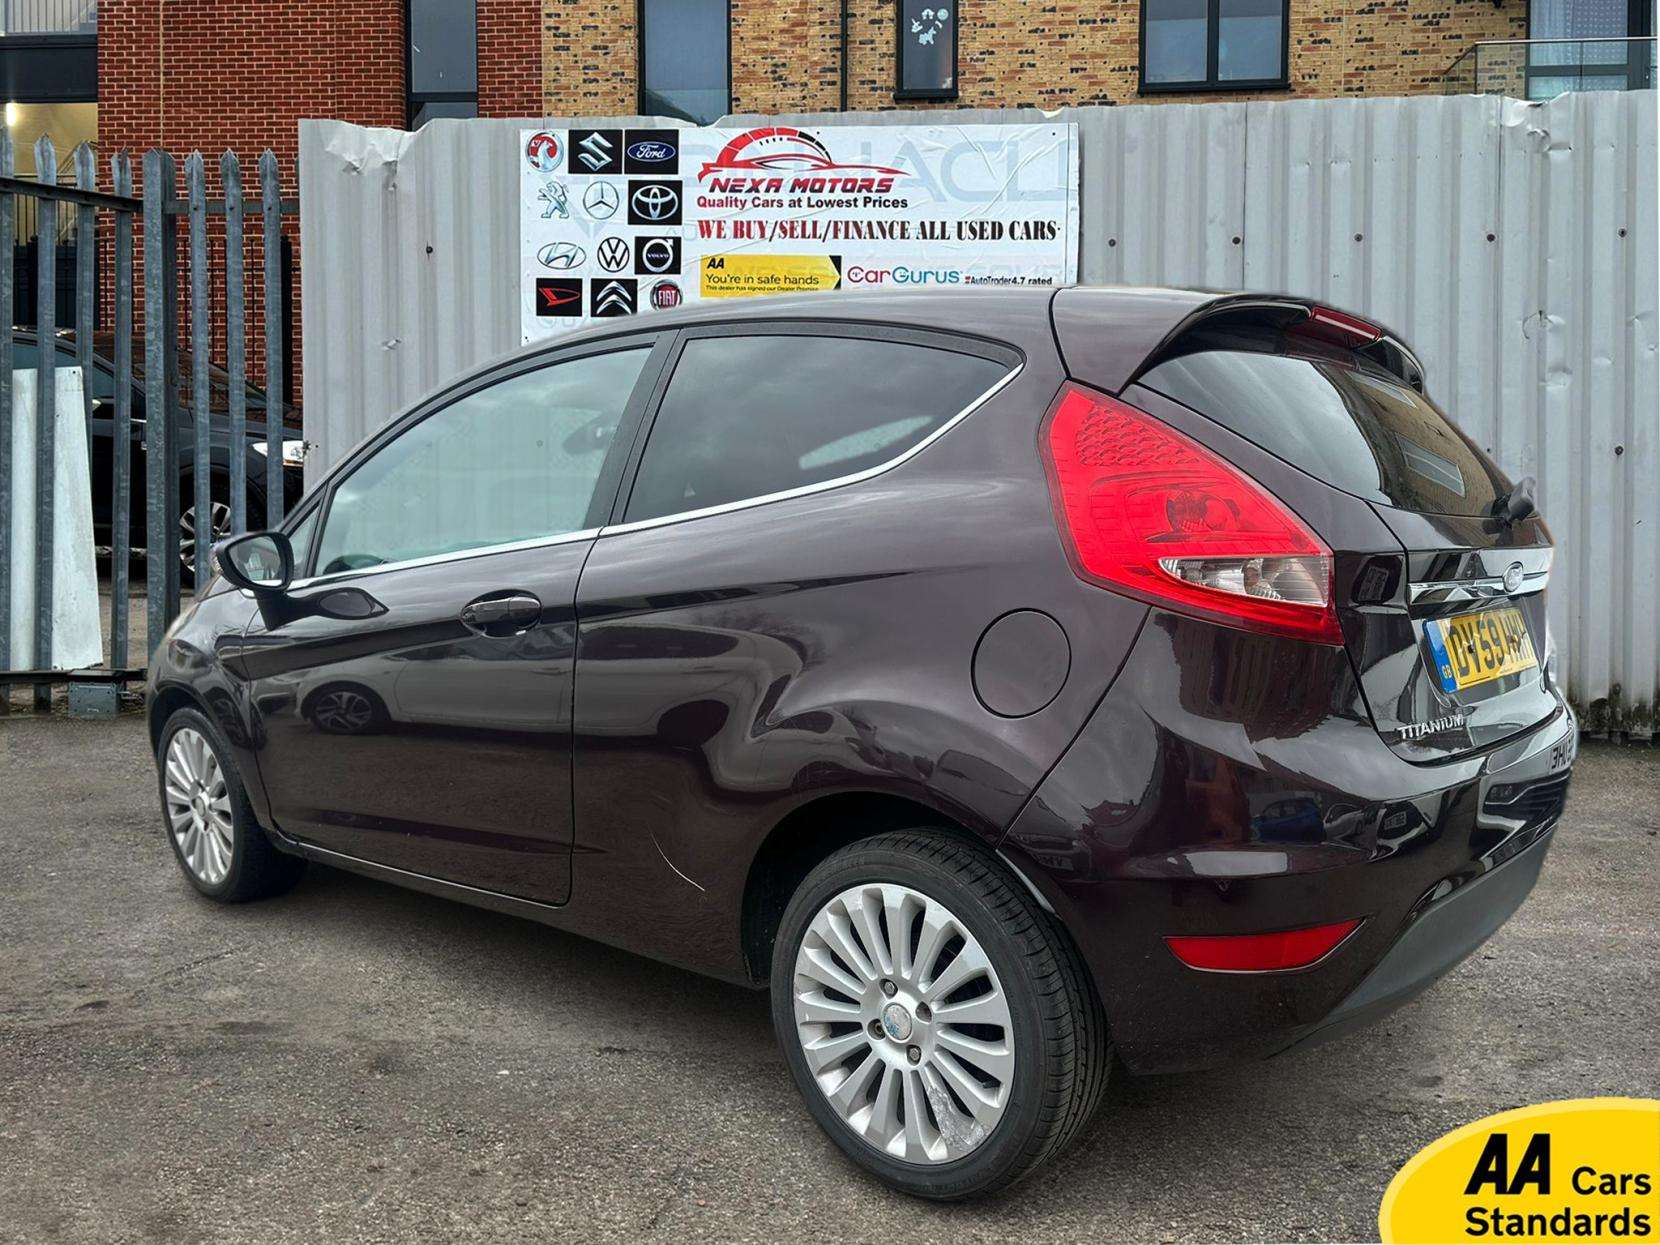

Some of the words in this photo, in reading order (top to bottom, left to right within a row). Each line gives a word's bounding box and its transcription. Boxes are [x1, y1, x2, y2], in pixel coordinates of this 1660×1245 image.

[636, 144, 666, 159] Ford
[709, 178, 784, 194] NEXA
[789, 178, 894, 194] MOTORS
[697, 196, 748, 211] Quality
[752, 196, 784, 209] Cars
[788, 197, 803, 208] at
[807, 196, 859, 209] Lowest
[863, 196, 908, 209] Prices
[697, 220, 727, 240] WE
[732, 220, 911, 242] BUY/SELL/FINANCE
[916, 220, 951, 240] ALL
[956, 220, 1004, 240] USED
[1008, 220, 1057, 240] CARS
[707, 257, 725, 269] AA
[705, 273, 741, 284] You're
[744, 274, 754, 284] in
[757, 273, 781, 284] safe
[784, 274, 820, 285] hands
[847, 266, 960, 284] CarGurus
[1028, 276, 1053, 285] rated
[658, 290, 676, 306] FIAT
[1397, 714, 1464, 739] TITANIUM
